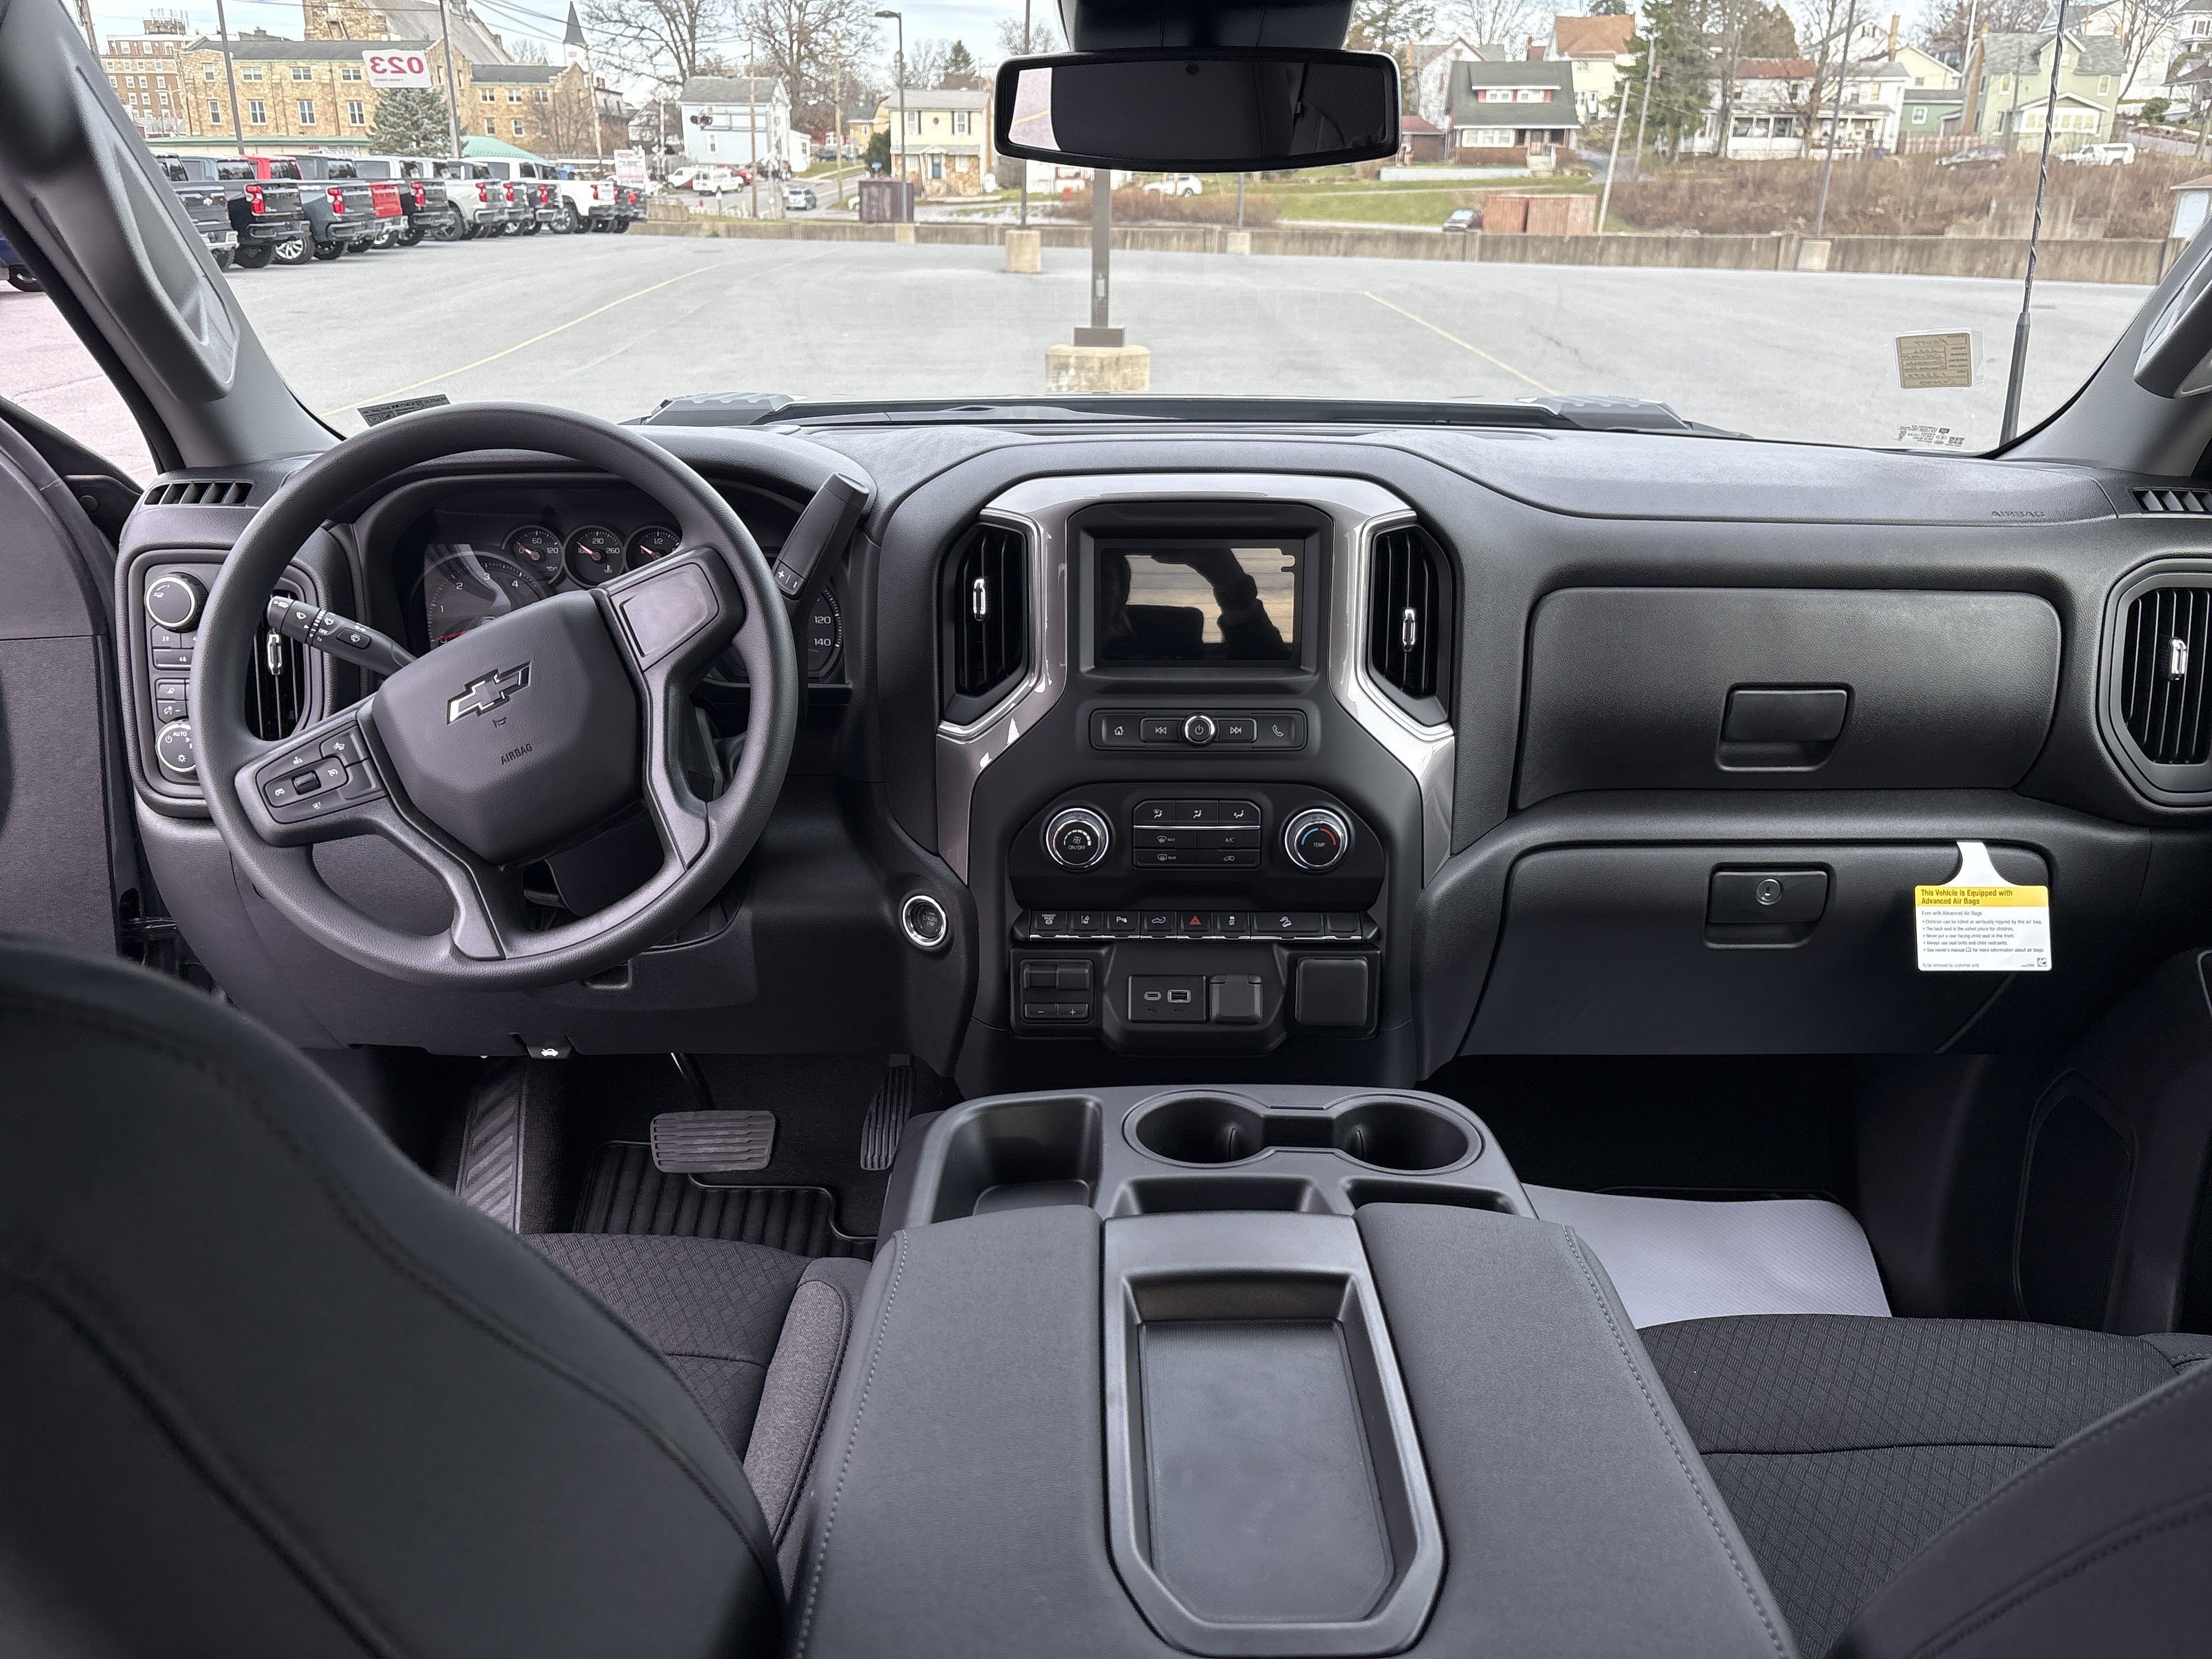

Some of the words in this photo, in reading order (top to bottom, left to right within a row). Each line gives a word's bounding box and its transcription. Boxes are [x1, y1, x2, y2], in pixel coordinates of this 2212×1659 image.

[814, 638, 831, 646] 140
[501, 743, 533, 765] AIRBAG
[1967, 889, 1996, 898] Equipped
[1964, 898, 1980, 906] Bags
[922, 915, 938, 923] ENGINE
